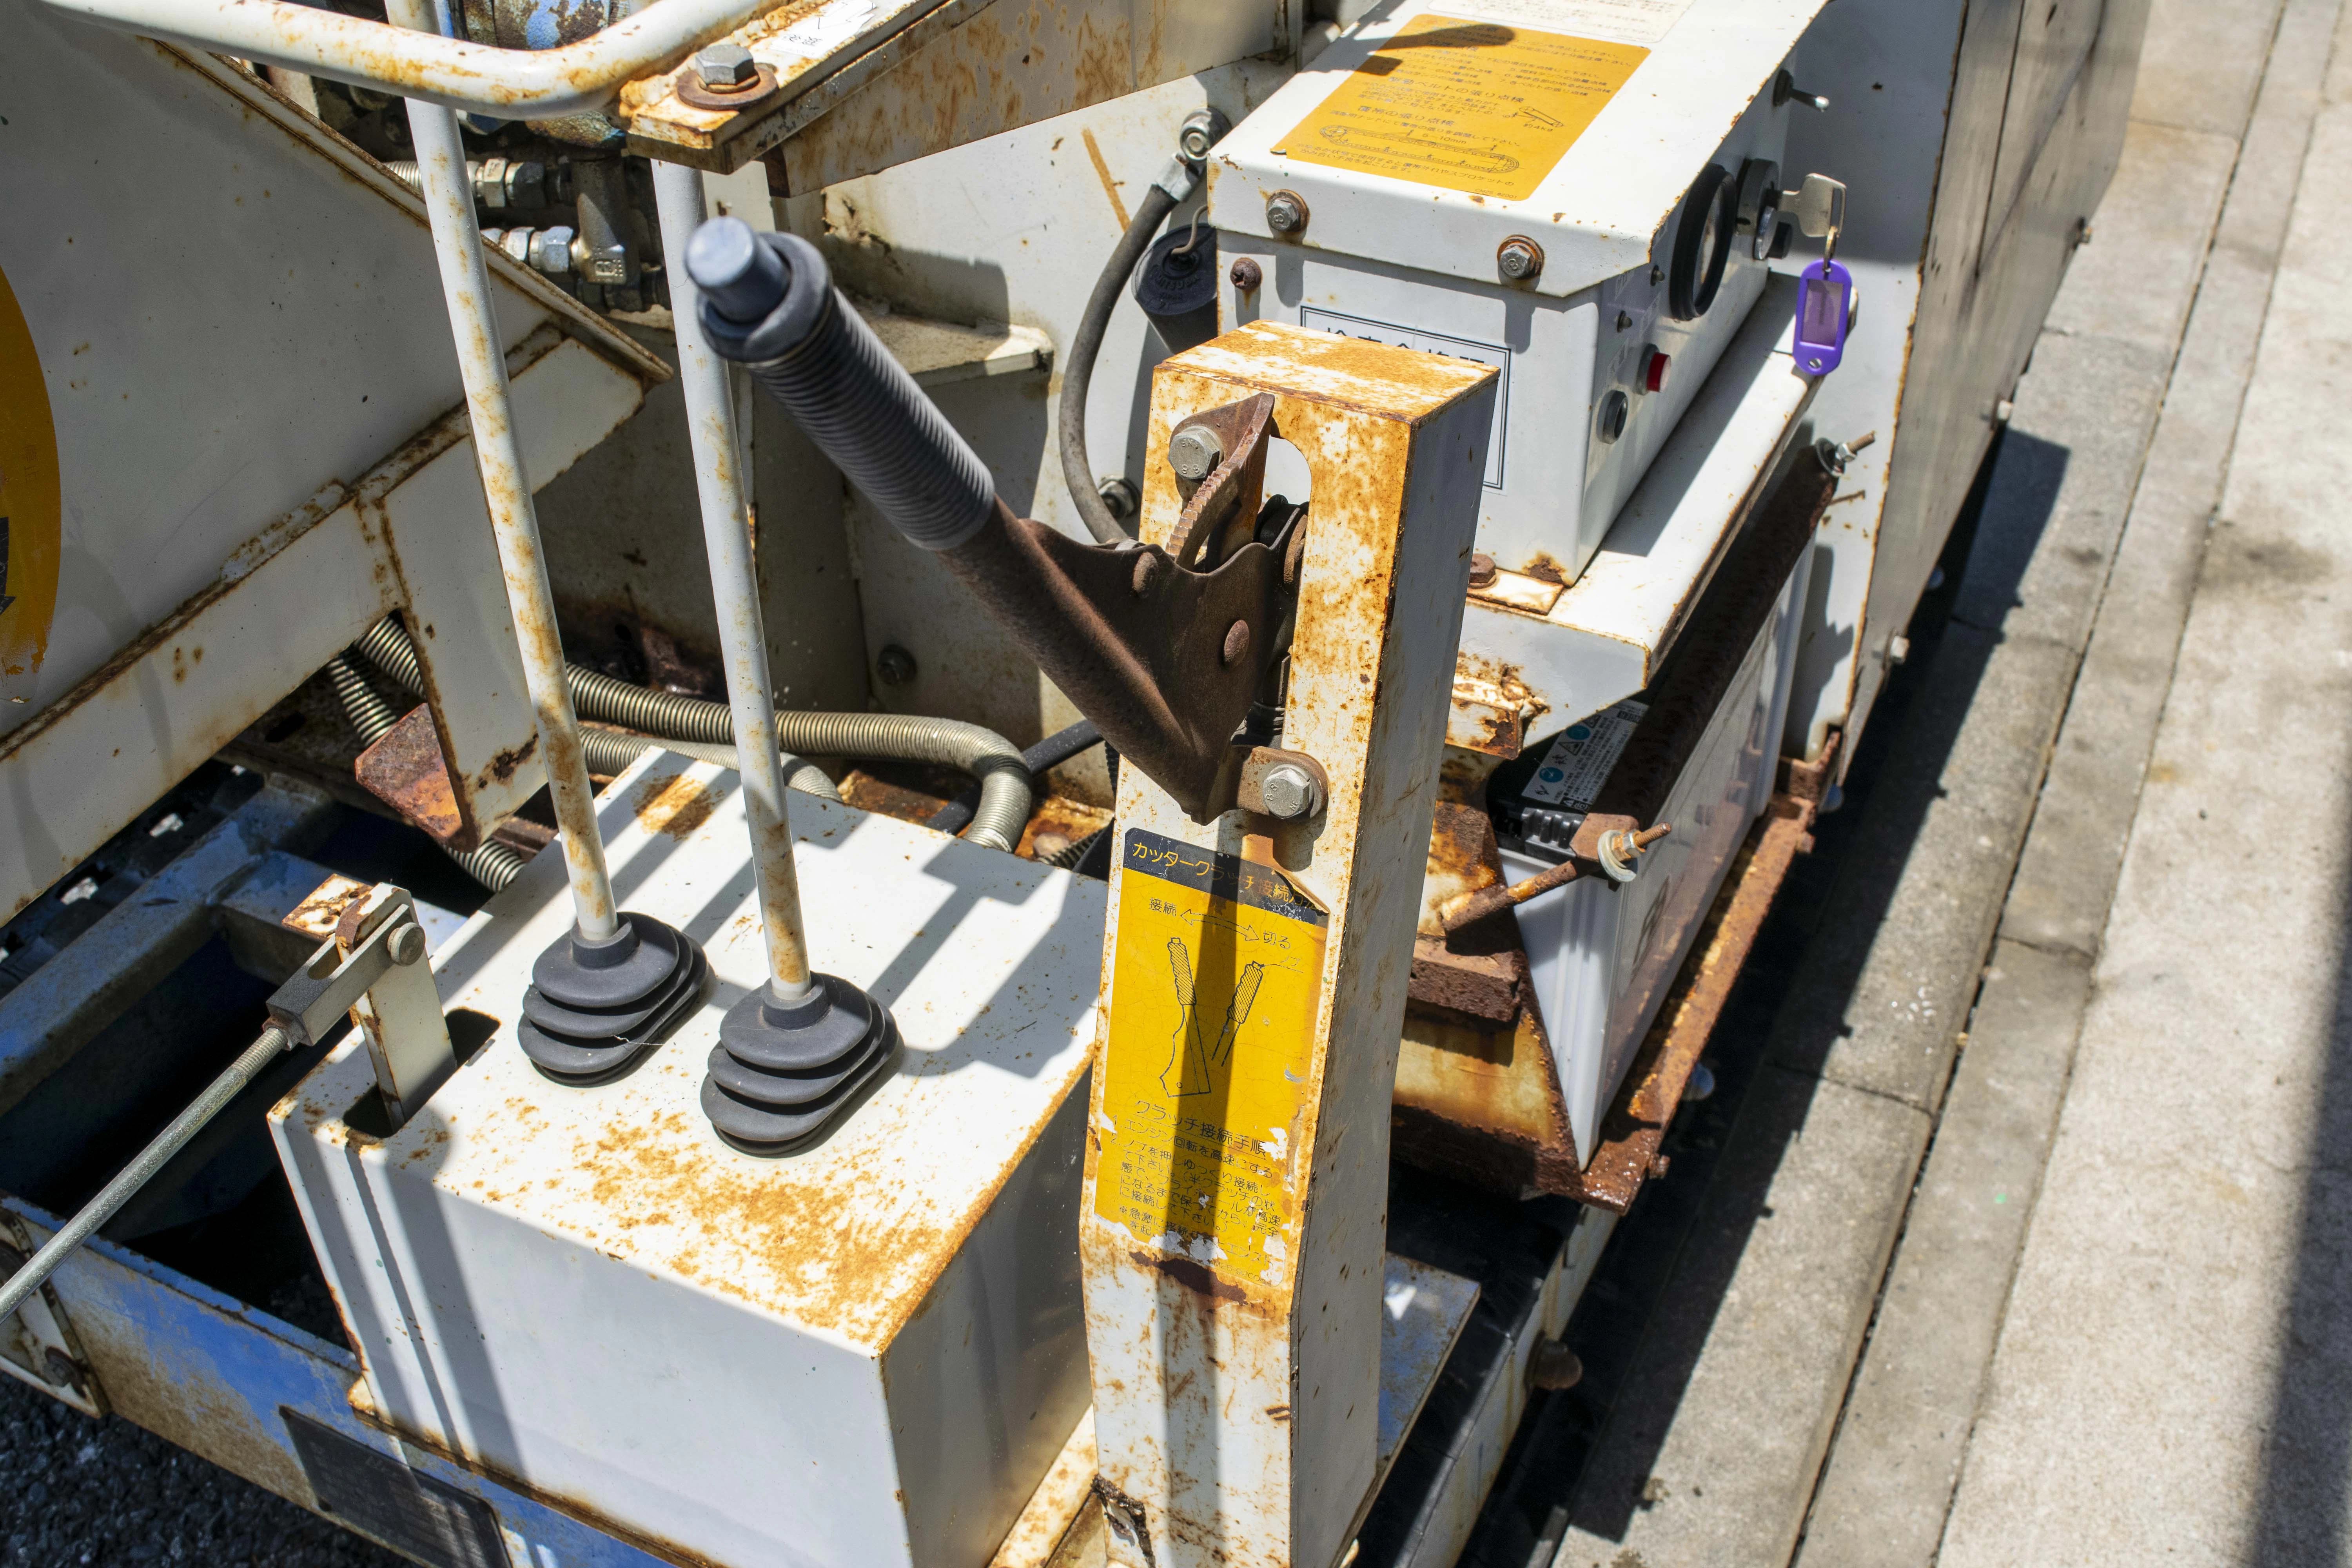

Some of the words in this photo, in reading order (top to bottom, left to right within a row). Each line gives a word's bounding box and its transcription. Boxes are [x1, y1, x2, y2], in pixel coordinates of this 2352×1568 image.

[1149, 897, 1177, 917] 接続
[1263, 931, 1291, 949] 切る
[1135, 1100, 1265, 1158] クラッチ接続手順
